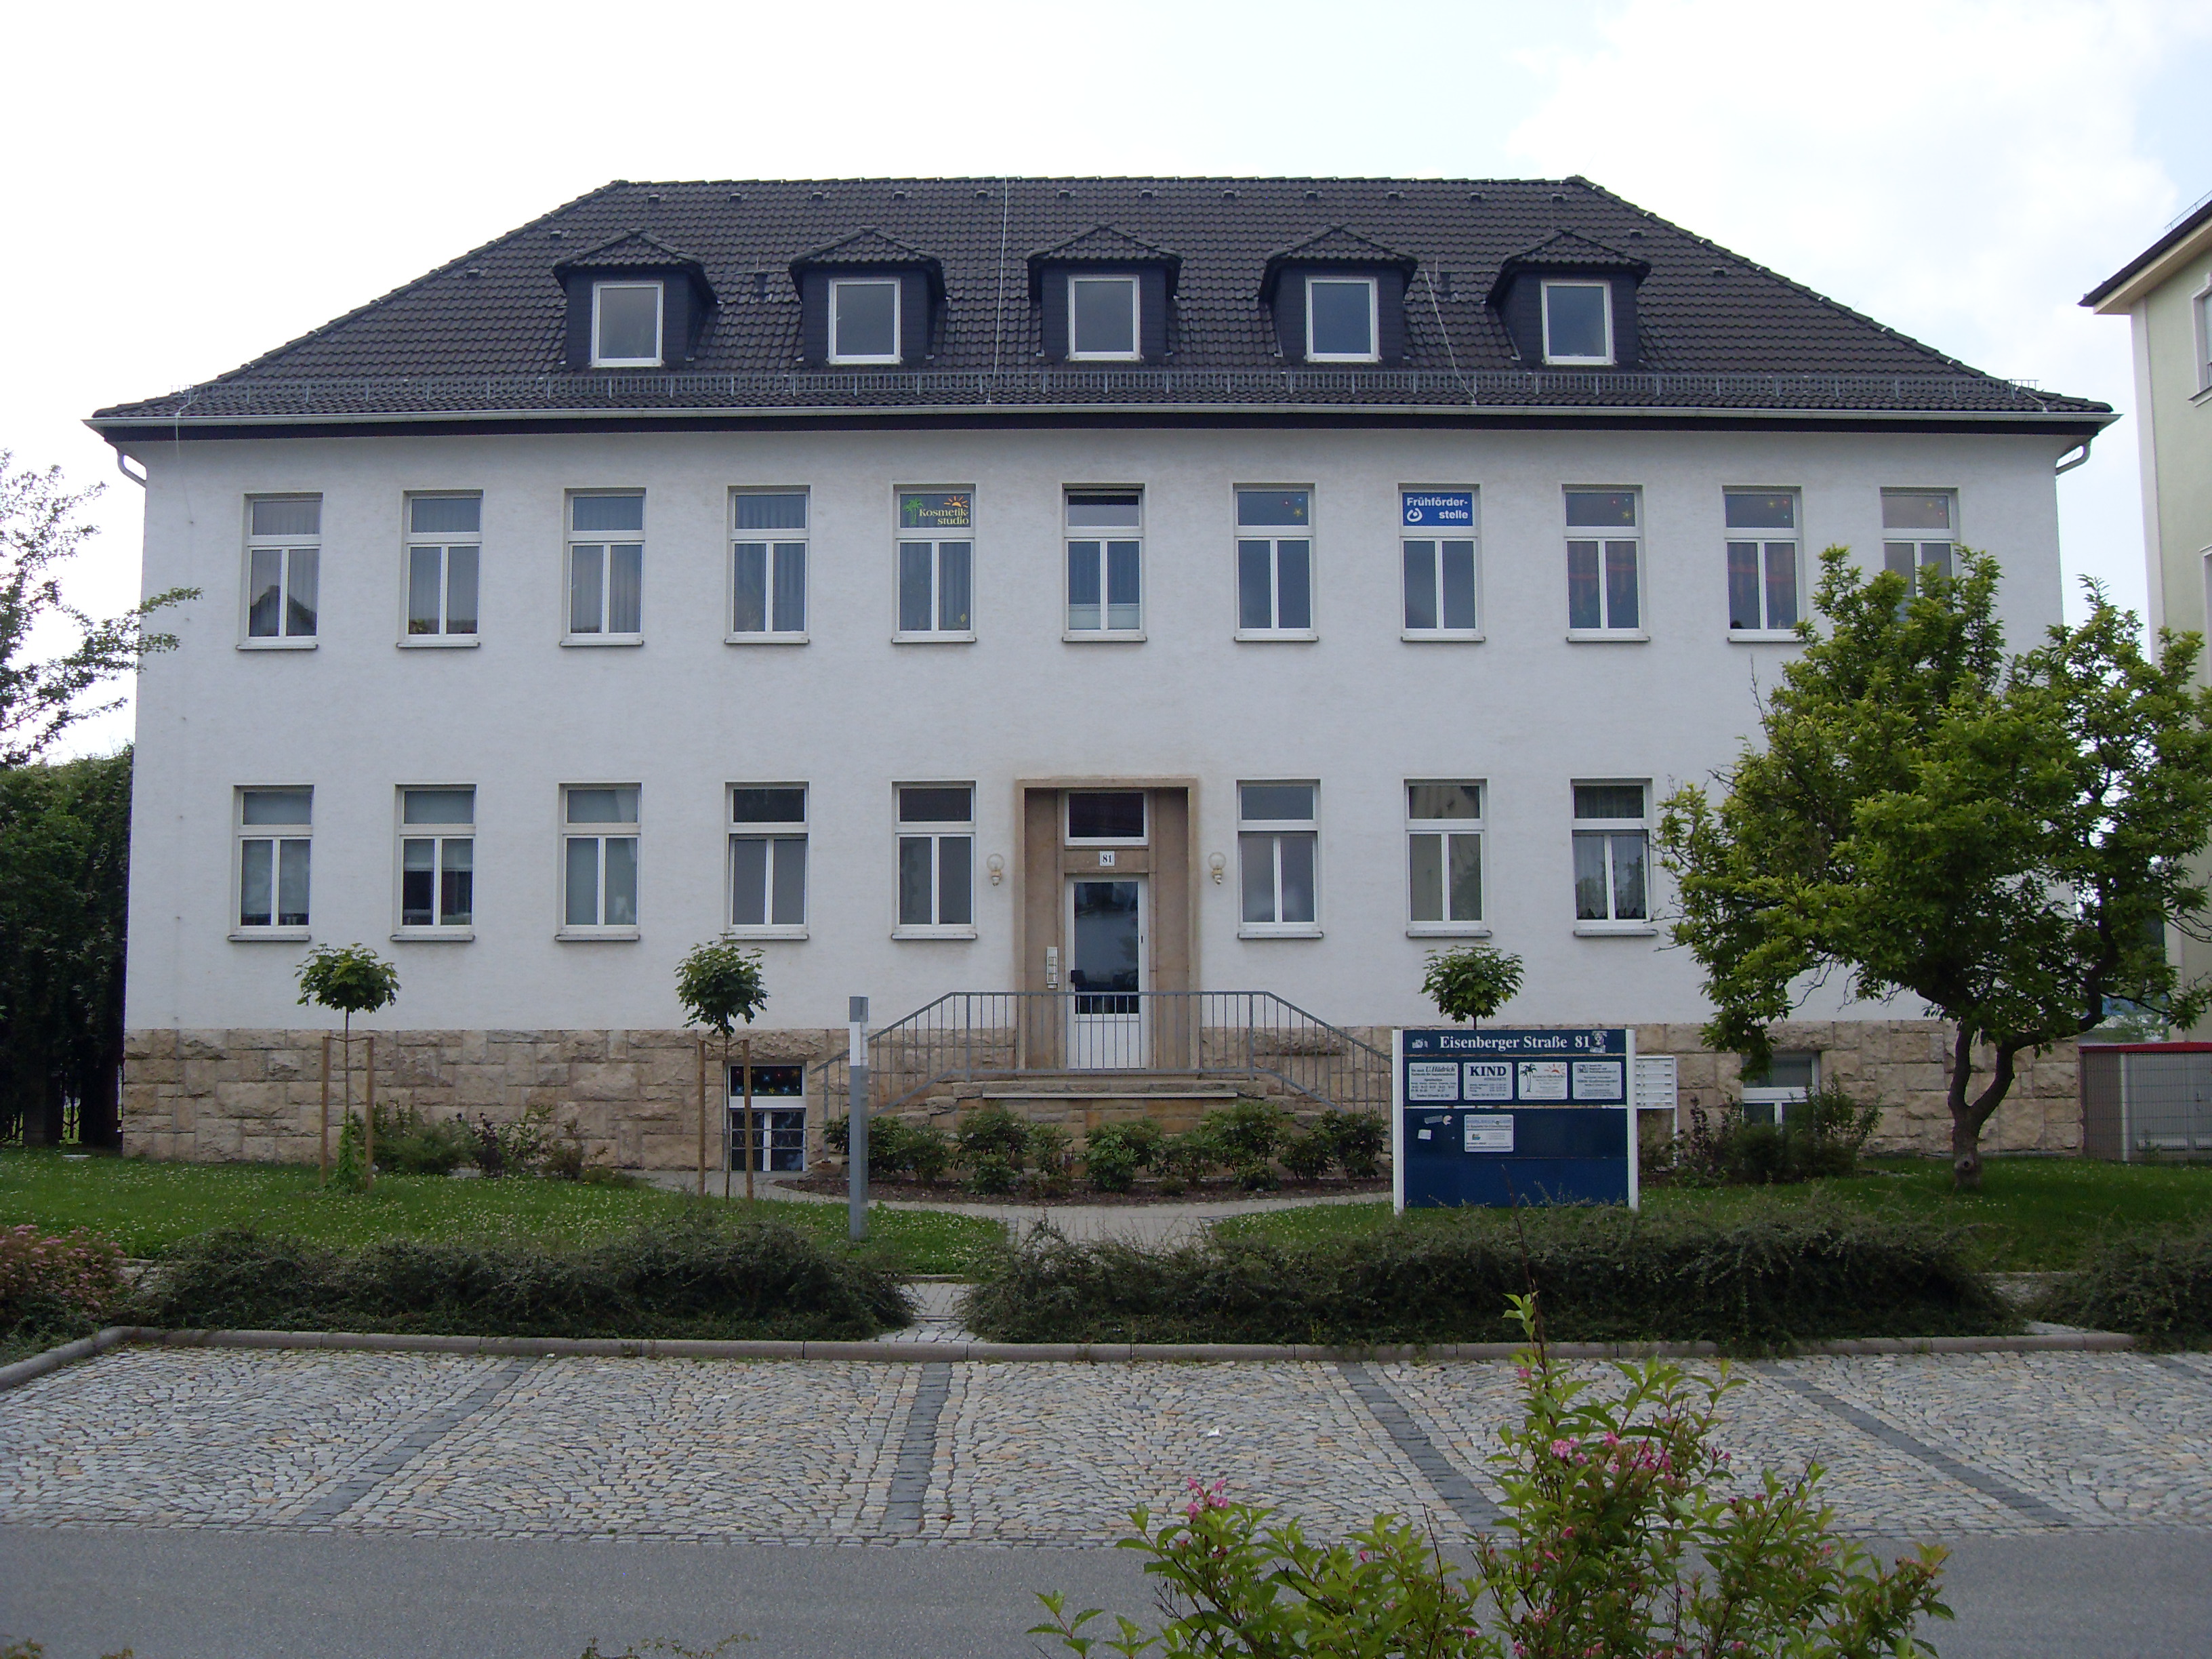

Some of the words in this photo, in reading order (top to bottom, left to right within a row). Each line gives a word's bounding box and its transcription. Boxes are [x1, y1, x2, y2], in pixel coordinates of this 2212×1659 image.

[1407, 497, 1468, 506] Frühförder-
[919, 508, 969, 516] Kosmetik-
[1439, 510, 1469, 519] stelle
[937, 516, 969, 525] studio
[1102, 855, 1112, 863] 81
[1439, 1036, 1519, 1052] Eisenberger
[1523, 1036, 1568, 1048] Straße
[1574, 1036, 1590, 1048] 81
[1469, 1065, 1507, 1076] KIND
